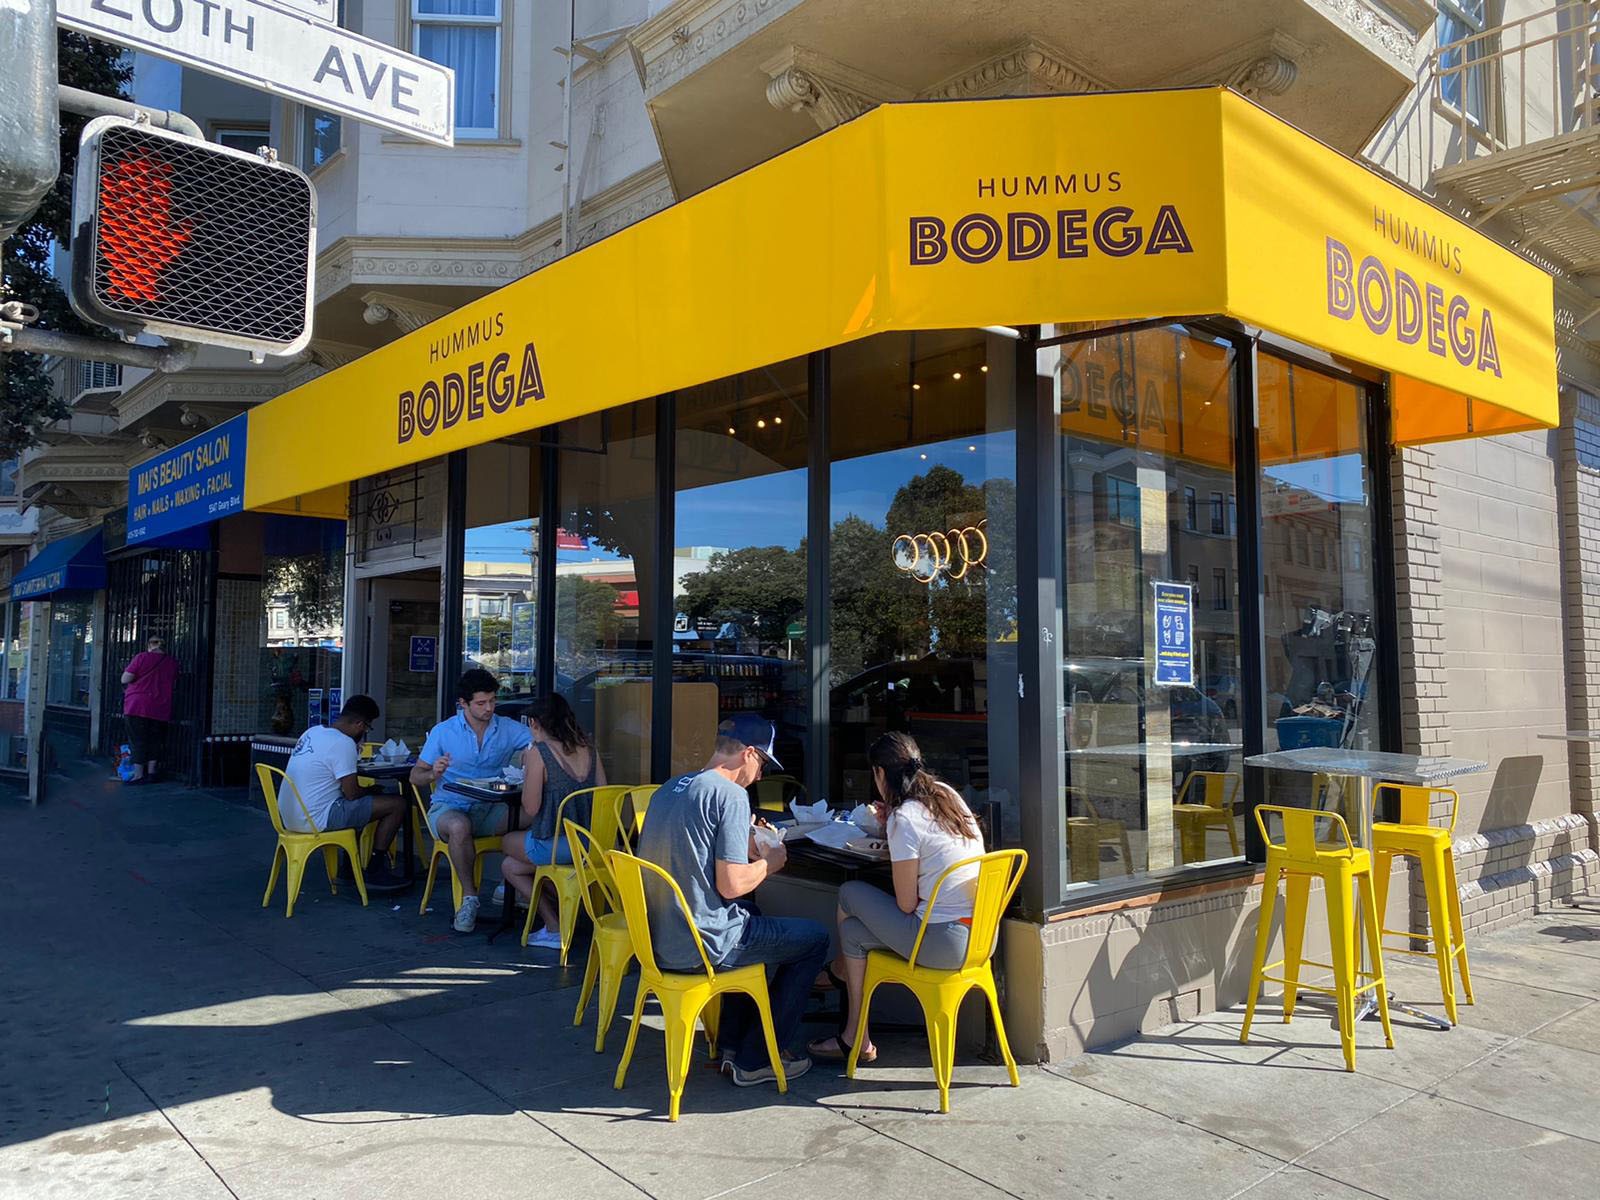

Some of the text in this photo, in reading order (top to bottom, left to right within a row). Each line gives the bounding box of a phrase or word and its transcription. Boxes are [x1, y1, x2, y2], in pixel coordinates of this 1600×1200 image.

[313, 45, 420, 116] AVE
[979, 172, 1122, 198] HUMMUS
[909, 205, 1194, 266] BODEGA
[1374, 204, 1462, 275] HUMMUS
[430, 312, 504, 364] HUMMUS
[1326, 235, 1503, 379] BODEGA
[397, 342, 546, 445] BODEGA
[137, 433, 230, 495] MAI'S BEAUTY SALON
[134, 471, 233, 521] HAIR NAILS WAXING FACIAL
